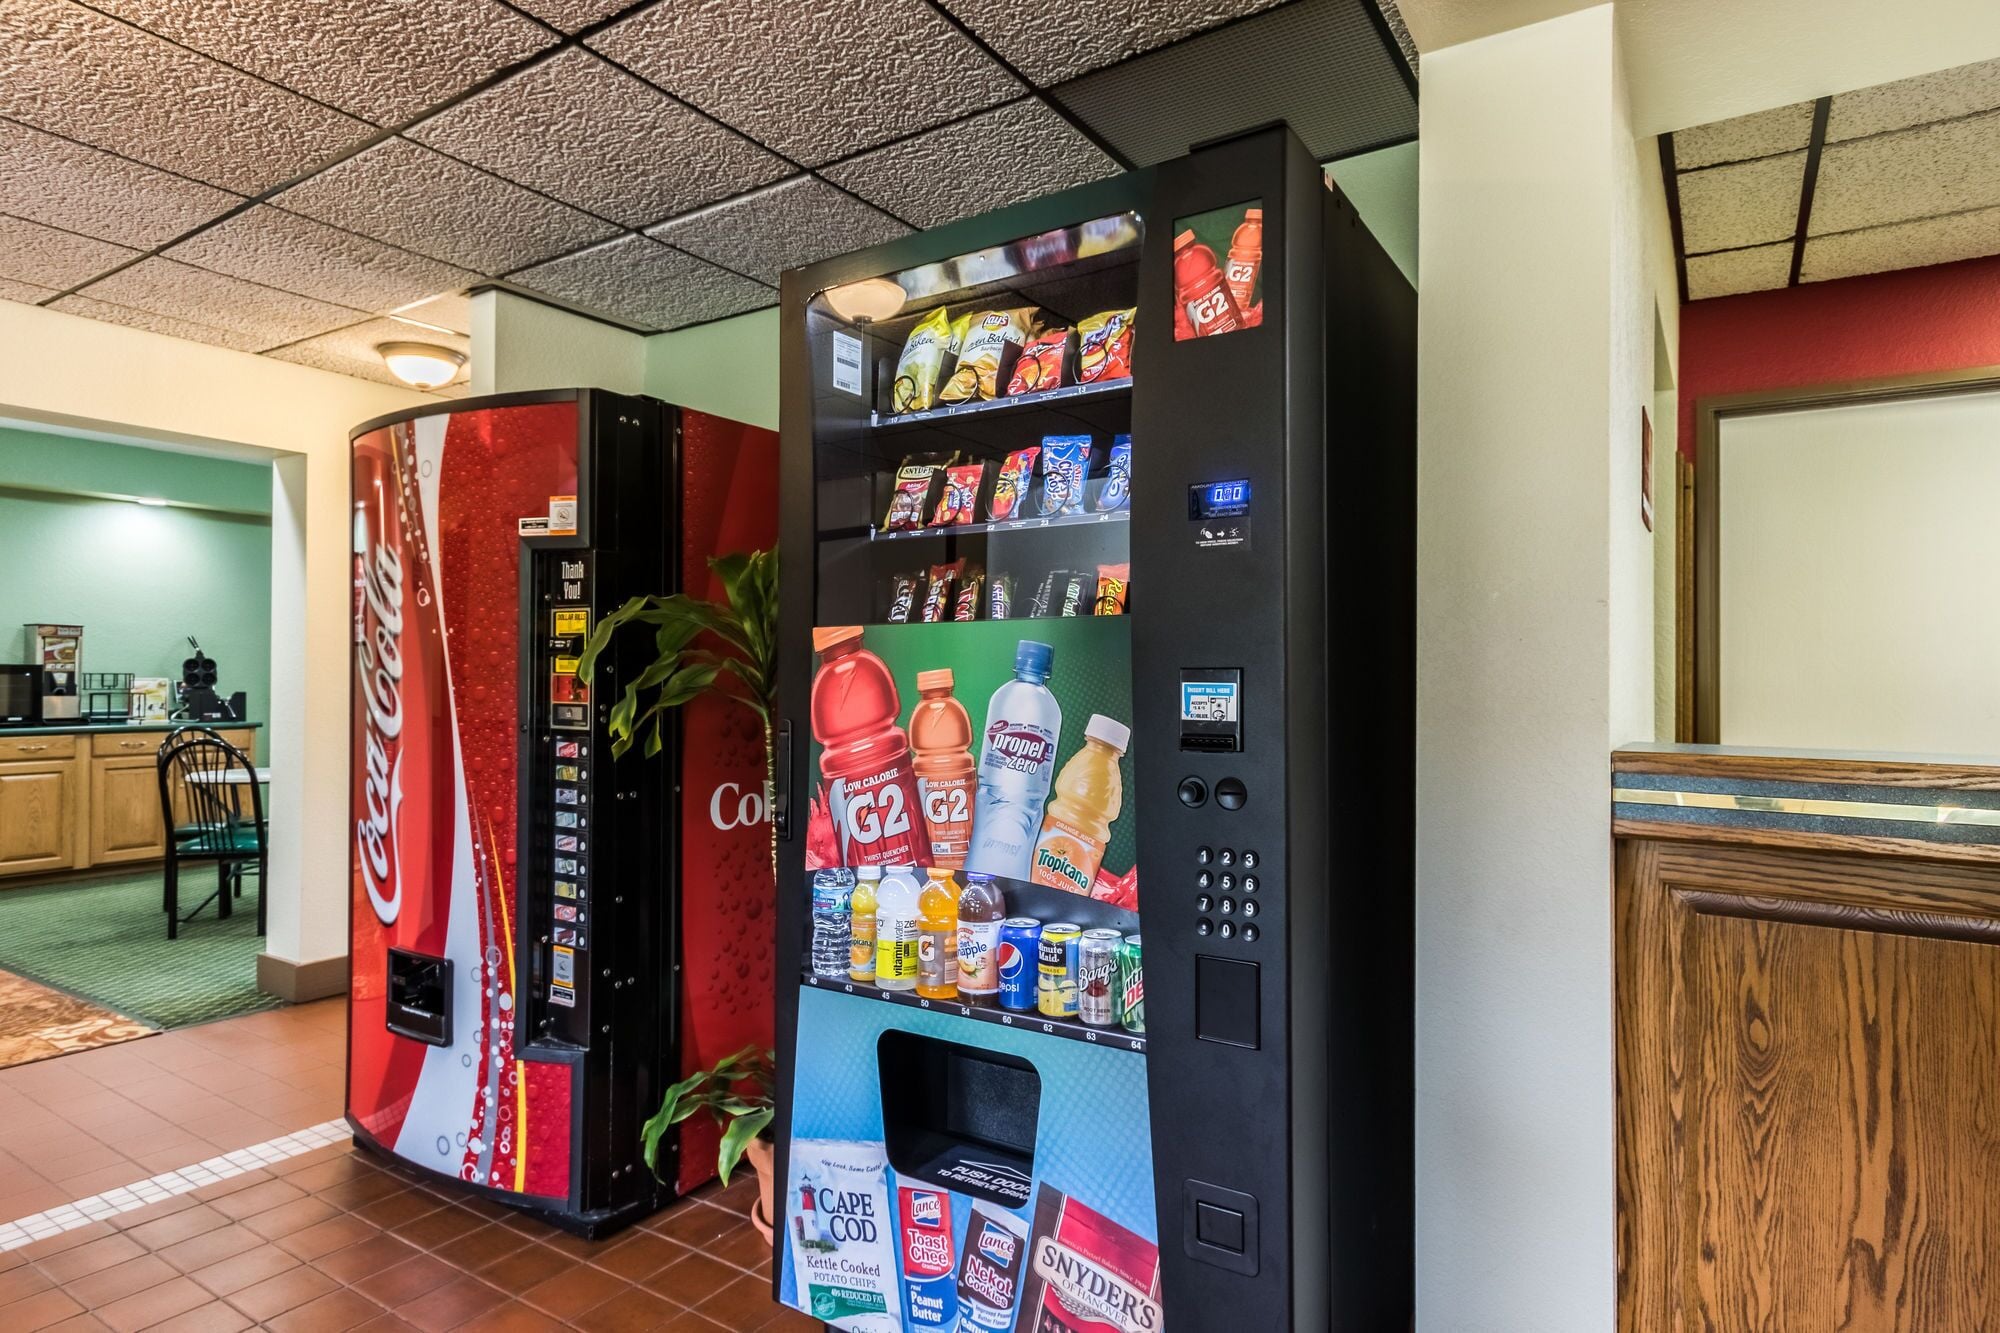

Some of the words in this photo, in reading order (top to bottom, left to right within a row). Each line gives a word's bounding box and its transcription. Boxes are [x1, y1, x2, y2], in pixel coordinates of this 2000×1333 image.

[1229, 265, 1253, 282] G2
[1196, 292, 1229, 324] G2
[1059, 460, 1072, 494] Chips
[561, 561, 584, 579] Thank
[563, 582, 581, 599] You!
[358, 543, 403, 924] Coca-Cola
[991, 733, 1046, 759] propel
[1007, 756, 1038, 775] zero
[844, 781, 863, 793] LOW
[864, 768, 899, 787] CALORIE
[940, 778, 967, 787] CALORIE
[846, 783, 911, 844] G2
[925, 789, 969, 824] G2
[1056, 821, 1080, 836] ORANGE
[1080, 831, 1096, 846] JUICE
[864, 854, 882, 862] THIRST
[882, 844, 909, 859] QUENCHER
[1201, 850, 1207, 862] 1
[1223, 852, 1231, 864] 2
[1245, 854, 1254, 866] 3
[1037, 848, 1090, 890] Tropicana
[1039, 868, 1057, 884] 100%
[1200, 874, 1208, 886] 4
[1223, 876, 1230, 888] 5
[1245, 878, 1254, 890] 6
[1201, 898, 1208, 910] 7
[1223, 900, 1230, 912] 8
[1245, 902, 1254, 915] 9
[1222, 924, 1230, 936] 0
[894, 919, 904, 977] vitaminwater
[809, 977, 818, 985] 40
[1079, 959, 1118, 992] Barq's
[882, 992, 890, 1000] 45
[1126, 981, 1144, 1009] DE
[1002, 1015, 1012, 1024] 60
[1043, 1023, 1053, 1032] 62
[1086, 1031, 1096, 1040] 63
[1131, 1041, 1141, 1049] 64
[952, 1166, 994, 1181] PUSH
[951, 1173, 1000, 1191] RETRIEVE
[998, 1187, 1030, 1199] DRIN
[819, 1188, 874, 1217] CAPE
[913, 1200, 940, 1217] Lance
[829, 1215, 877, 1243] COD
[908, 1228, 947, 1251] Toast
[979, 1232, 1015, 1253] Lance
[909, 1245, 949, 1266] Chee
[807, 1255, 837, 1271] Kettle
[841, 1260, 881, 1277] Cooked
[813, 1272, 847, 1285] POTATO
[849, 1277, 877, 1289] CHIPS
[966, 1254, 1013, 1298] Nekot
[841, 1289, 872, 1302] REDUCED
[872, 1294, 884, 1304] FAT
[965, 1273, 1008, 1309] Cookies
[1042, 1244, 1156, 1331] SNYDER'S
[910, 1290, 943, 1310] Peanut
[1062, 1279, 1077, 1293] OF
[1077, 1289, 1129, 1327] HANOVER
[911, 1304, 942, 1323] Butter
